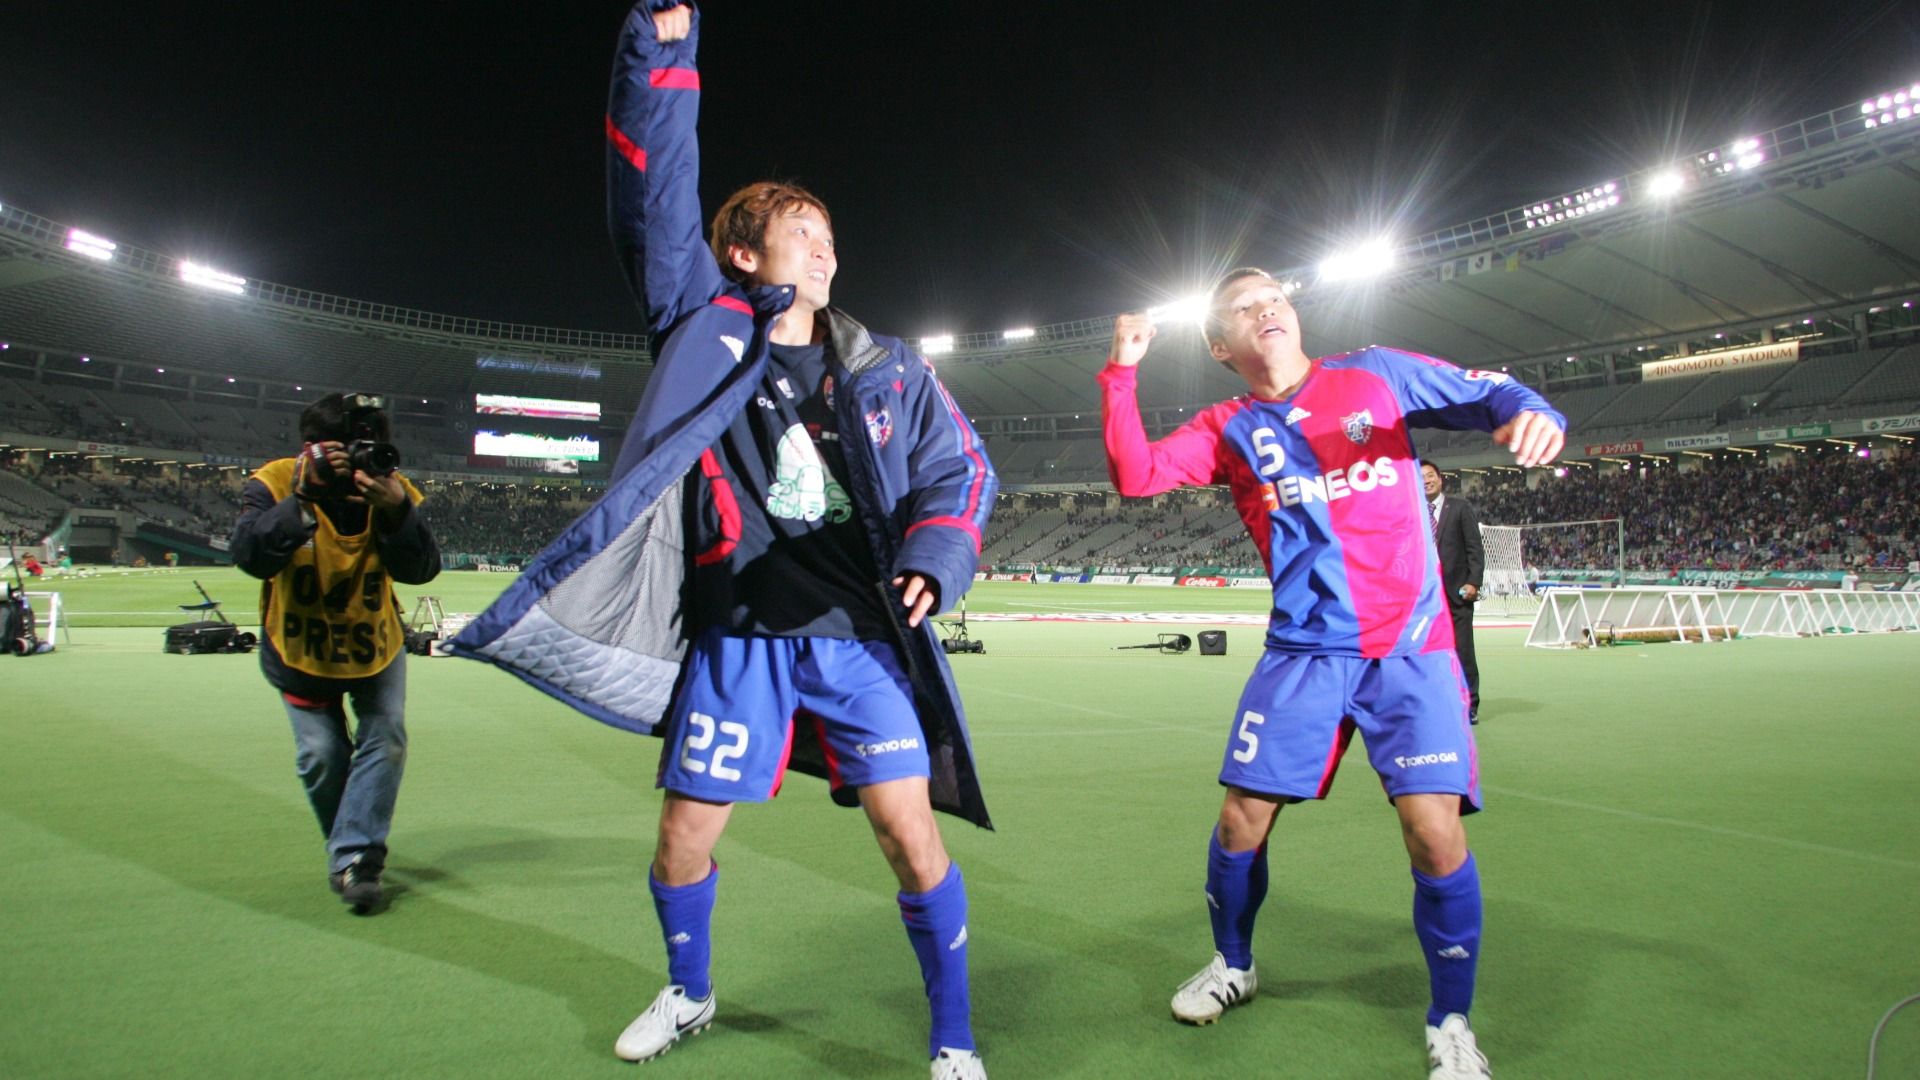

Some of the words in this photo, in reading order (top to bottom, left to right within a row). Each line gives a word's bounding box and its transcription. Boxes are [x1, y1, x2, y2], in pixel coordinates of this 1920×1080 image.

[1647, 357, 1725, 377] AJINOMOTO
[1731, 347, 1793, 366] STADIUM
[1251, 427, 1285, 477] 5
[1276, 456, 1399, 507] ENEOS
[293, 564, 386, 614] 045
[284, 612, 388, 665] PRESS
[681, 711, 749, 782] 22
[866, 740, 900, 756] TOKYO
[899, 737, 920, 750] GAS
[1232, 710, 1265, 764] 5
[1405, 753, 1439, 768] TOKYO
